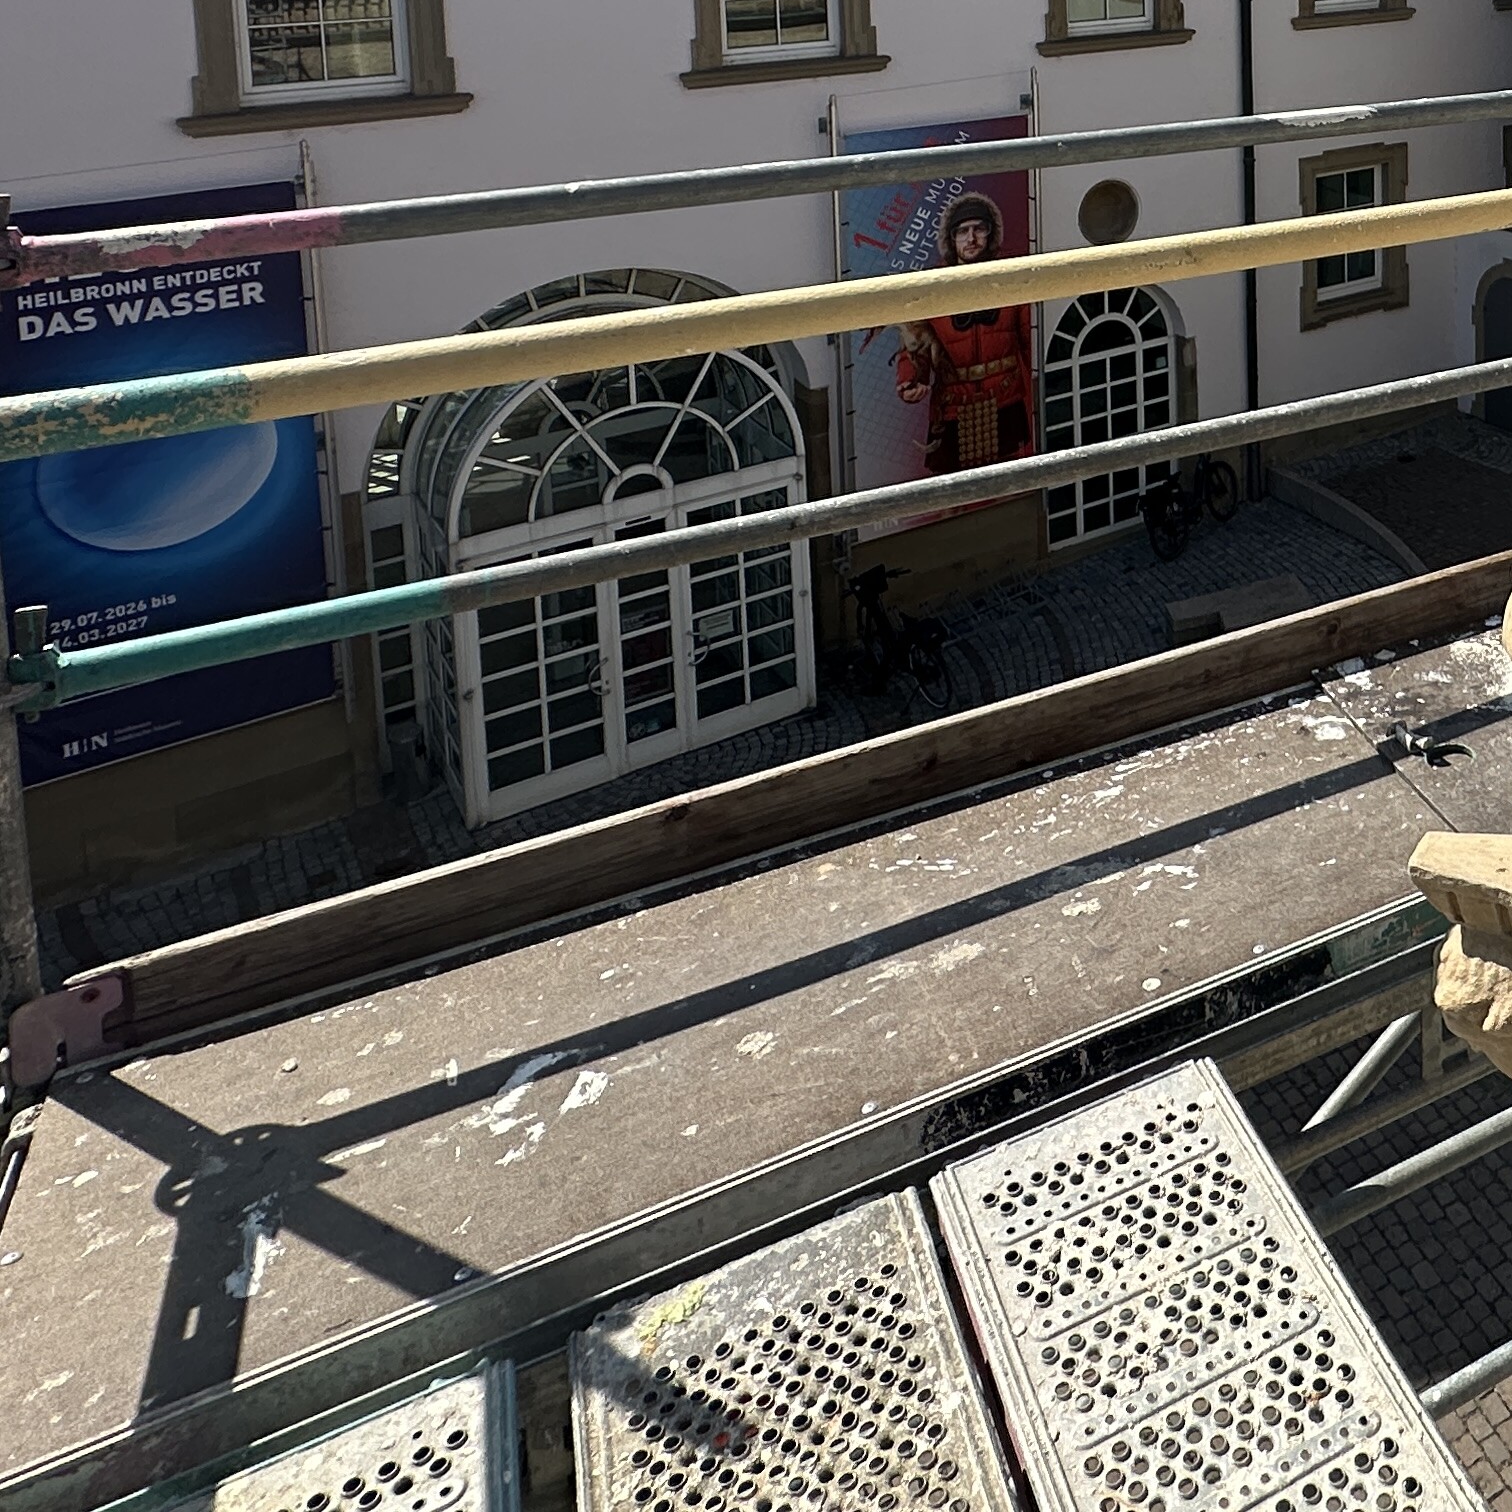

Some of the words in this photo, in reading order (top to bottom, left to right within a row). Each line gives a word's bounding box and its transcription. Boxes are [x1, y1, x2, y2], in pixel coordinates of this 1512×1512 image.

[899, 206, 931, 254] NEUE
[17, 278, 147, 310] HEILBRONN
[153, 261, 262, 290] ENTDECKT
[18, 307, 98, 341] DAS
[106, 282, 266, 327] WASSER
[50, 600, 147, 635] 29.07.2026
[151, 594, 177, 609] bis
